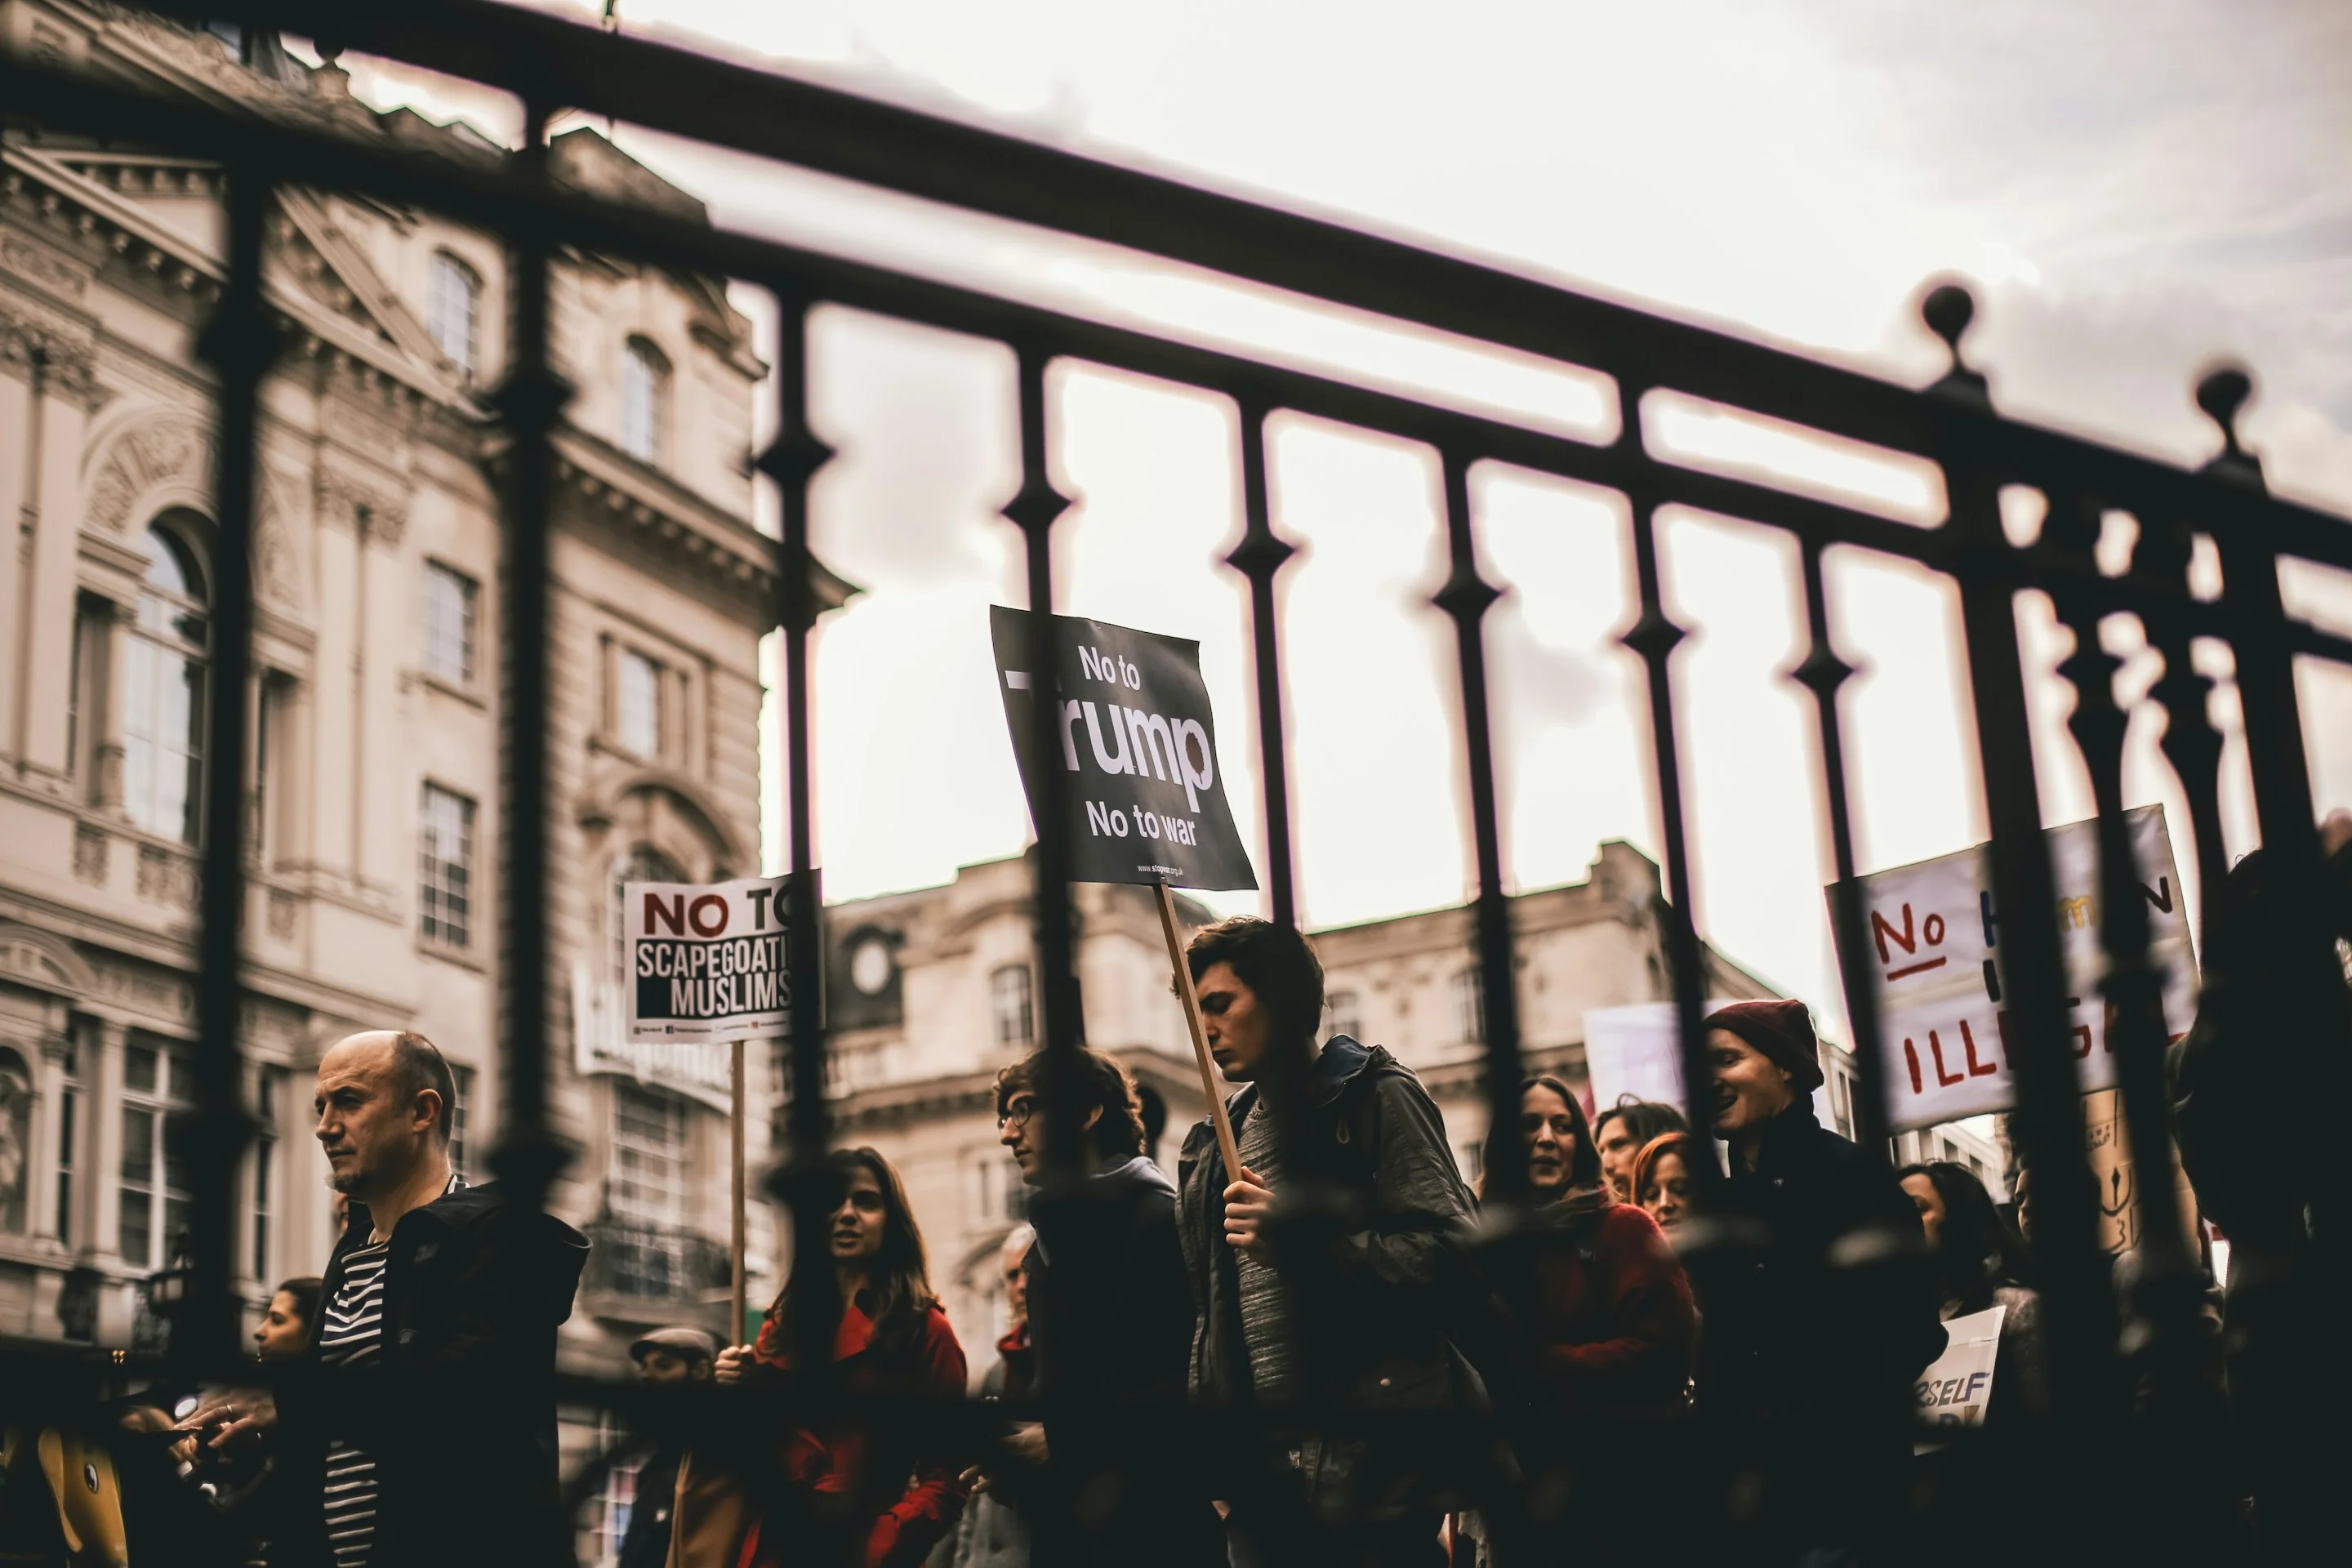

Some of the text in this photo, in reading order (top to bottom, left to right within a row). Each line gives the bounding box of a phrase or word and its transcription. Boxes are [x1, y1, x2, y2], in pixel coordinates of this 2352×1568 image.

[1078, 645, 1141, 691] No to
[1085, 800, 1196, 846] No to war
[644, 893, 728, 938] NO
[637, 935, 788, 979] SCAPEGOATI
[670, 970, 792, 1017] MUSLIMS
[1917, 1372, 1990, 1407] RSELF
